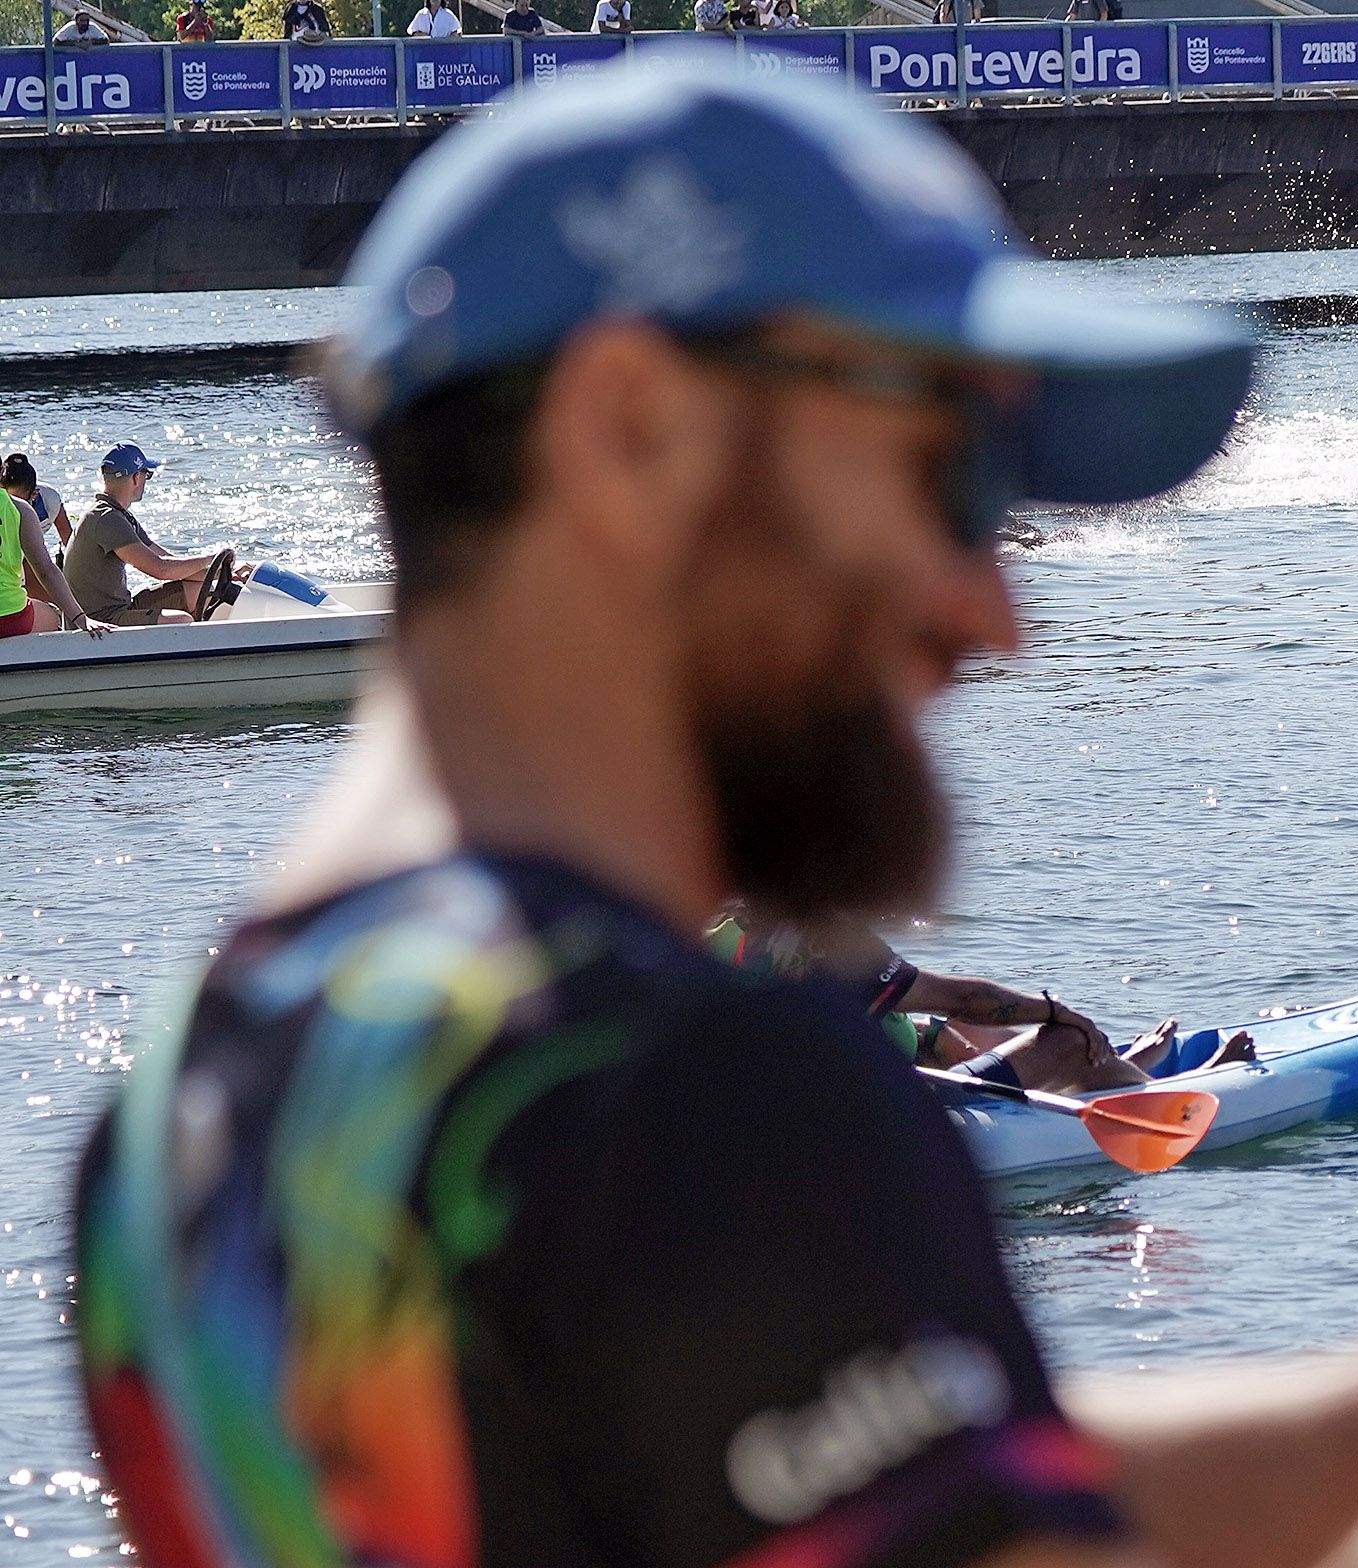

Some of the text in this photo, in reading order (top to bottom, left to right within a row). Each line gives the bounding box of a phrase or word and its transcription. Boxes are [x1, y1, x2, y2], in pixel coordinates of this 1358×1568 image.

[1213, 47, 1246, 56] Concello
[1302, 41, 1357, 65] 226ERS
[869, 36, 1141, 88] Pontevedra
[1213, 55, 1266, 65] de Pontevedra
[330, 66, 387, 78] Deputación
[438, 63, 477, 75] XUNTA
[211, 72, 248, 81] Concello
[330, 76, 387, 87] Pontevedra
[438, 75, 501, 86] DE GALICIA
[212, 81, 271, 91] de Pontevedra
